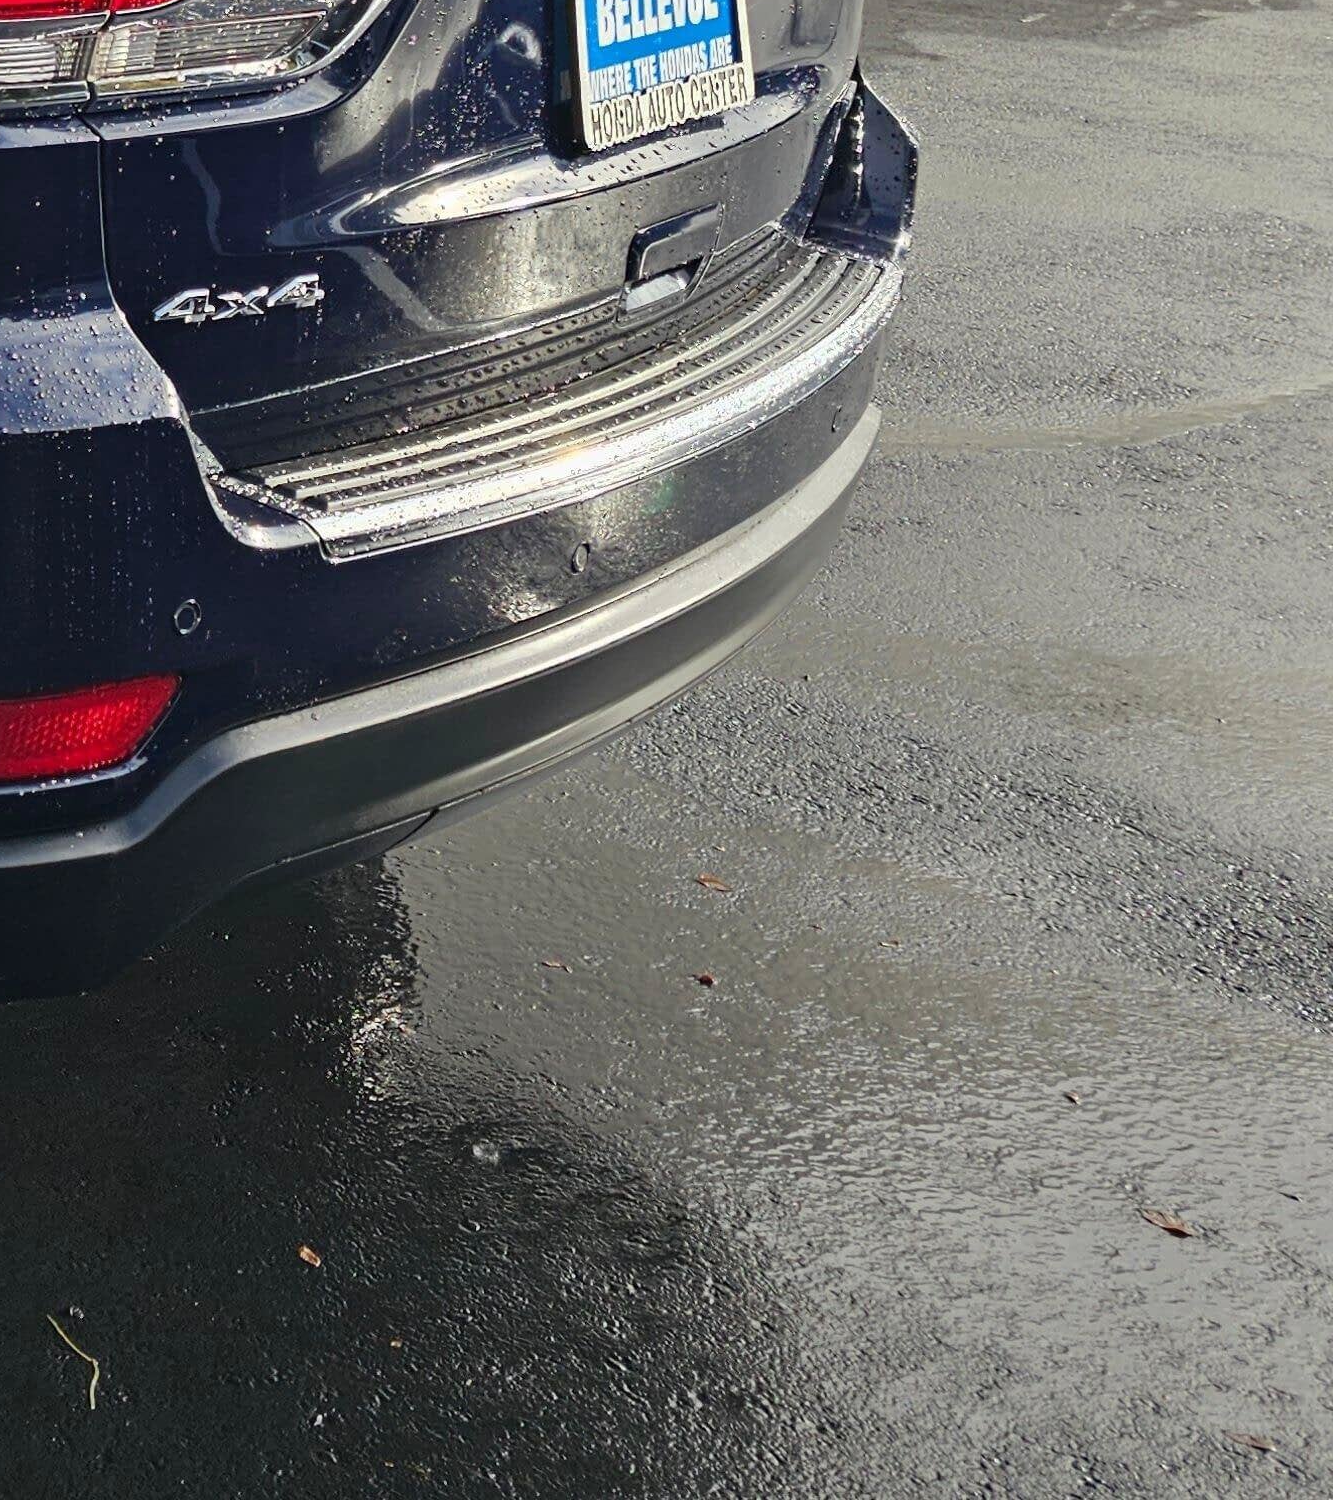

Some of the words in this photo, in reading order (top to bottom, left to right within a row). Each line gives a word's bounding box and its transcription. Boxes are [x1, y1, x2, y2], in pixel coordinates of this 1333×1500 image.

[589, 62, 632, 100] WHERE
[633, 55, 658, 91] THE
[659, 41, 708, 83] HONDAS
[709, 34, 733, 69] ARE
[590, 94, 644, 146] HONDA
[647, 82, 686, 129] AUTO
[689, 65, 748, 117] CENTER
